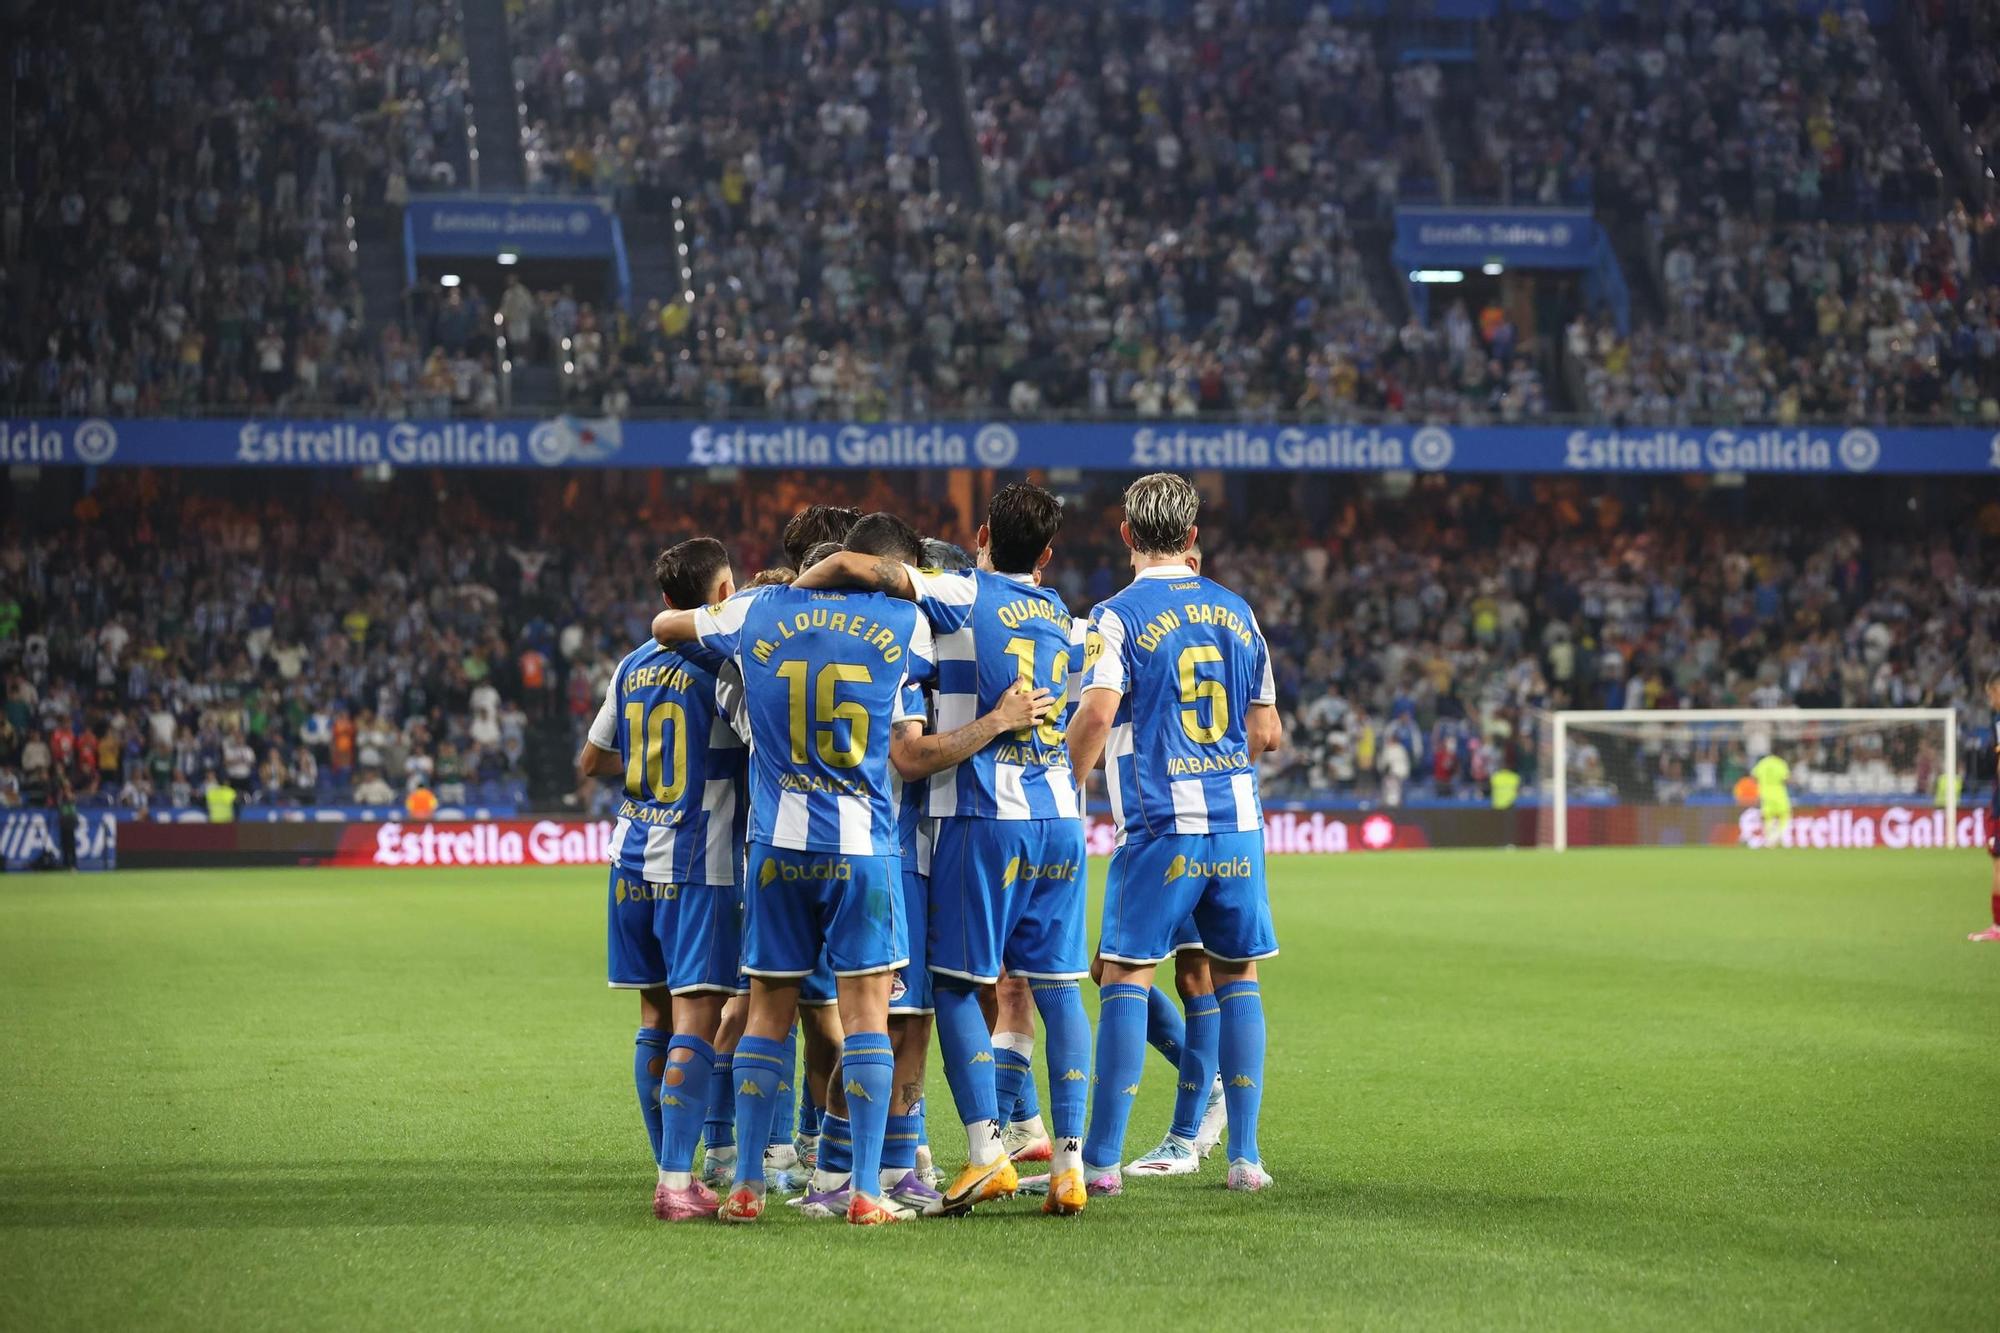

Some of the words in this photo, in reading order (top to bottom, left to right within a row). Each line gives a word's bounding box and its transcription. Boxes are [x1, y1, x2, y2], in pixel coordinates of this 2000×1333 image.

[236, 423, 381, 462] Estrella
[387, 423, 519, 464] Galicia
[688, 426, 829, 465] Estrella
[836, 425, 966, 465] Galicia
[1131, 428, 1269, 468] Estrella
[1275, 428, 1403, 468] Galicia
[1565, 431, 1699, 469] Estrella
[1706, 430, 1830, 469] Galicia
[752, 638, 781, 664] M.
[777, 609, 902, 664] LOUREIRO
[997, 598, 1071, 641] QUAGLIA
[1136, 610, 1181, 653] DANI
[1184, 604, 1253, 648] BARCIA
[776, 660, 873, 768] 15
[1178, 645, 1230, 745] 5
[624, 702, 687, 803] 10
[374, 821, 524, 865] Estrella
[528, 819, 611, 864] Gali
[781, 857, 851, 881] bualá
[1188, 856, 1251, 878] bualá
